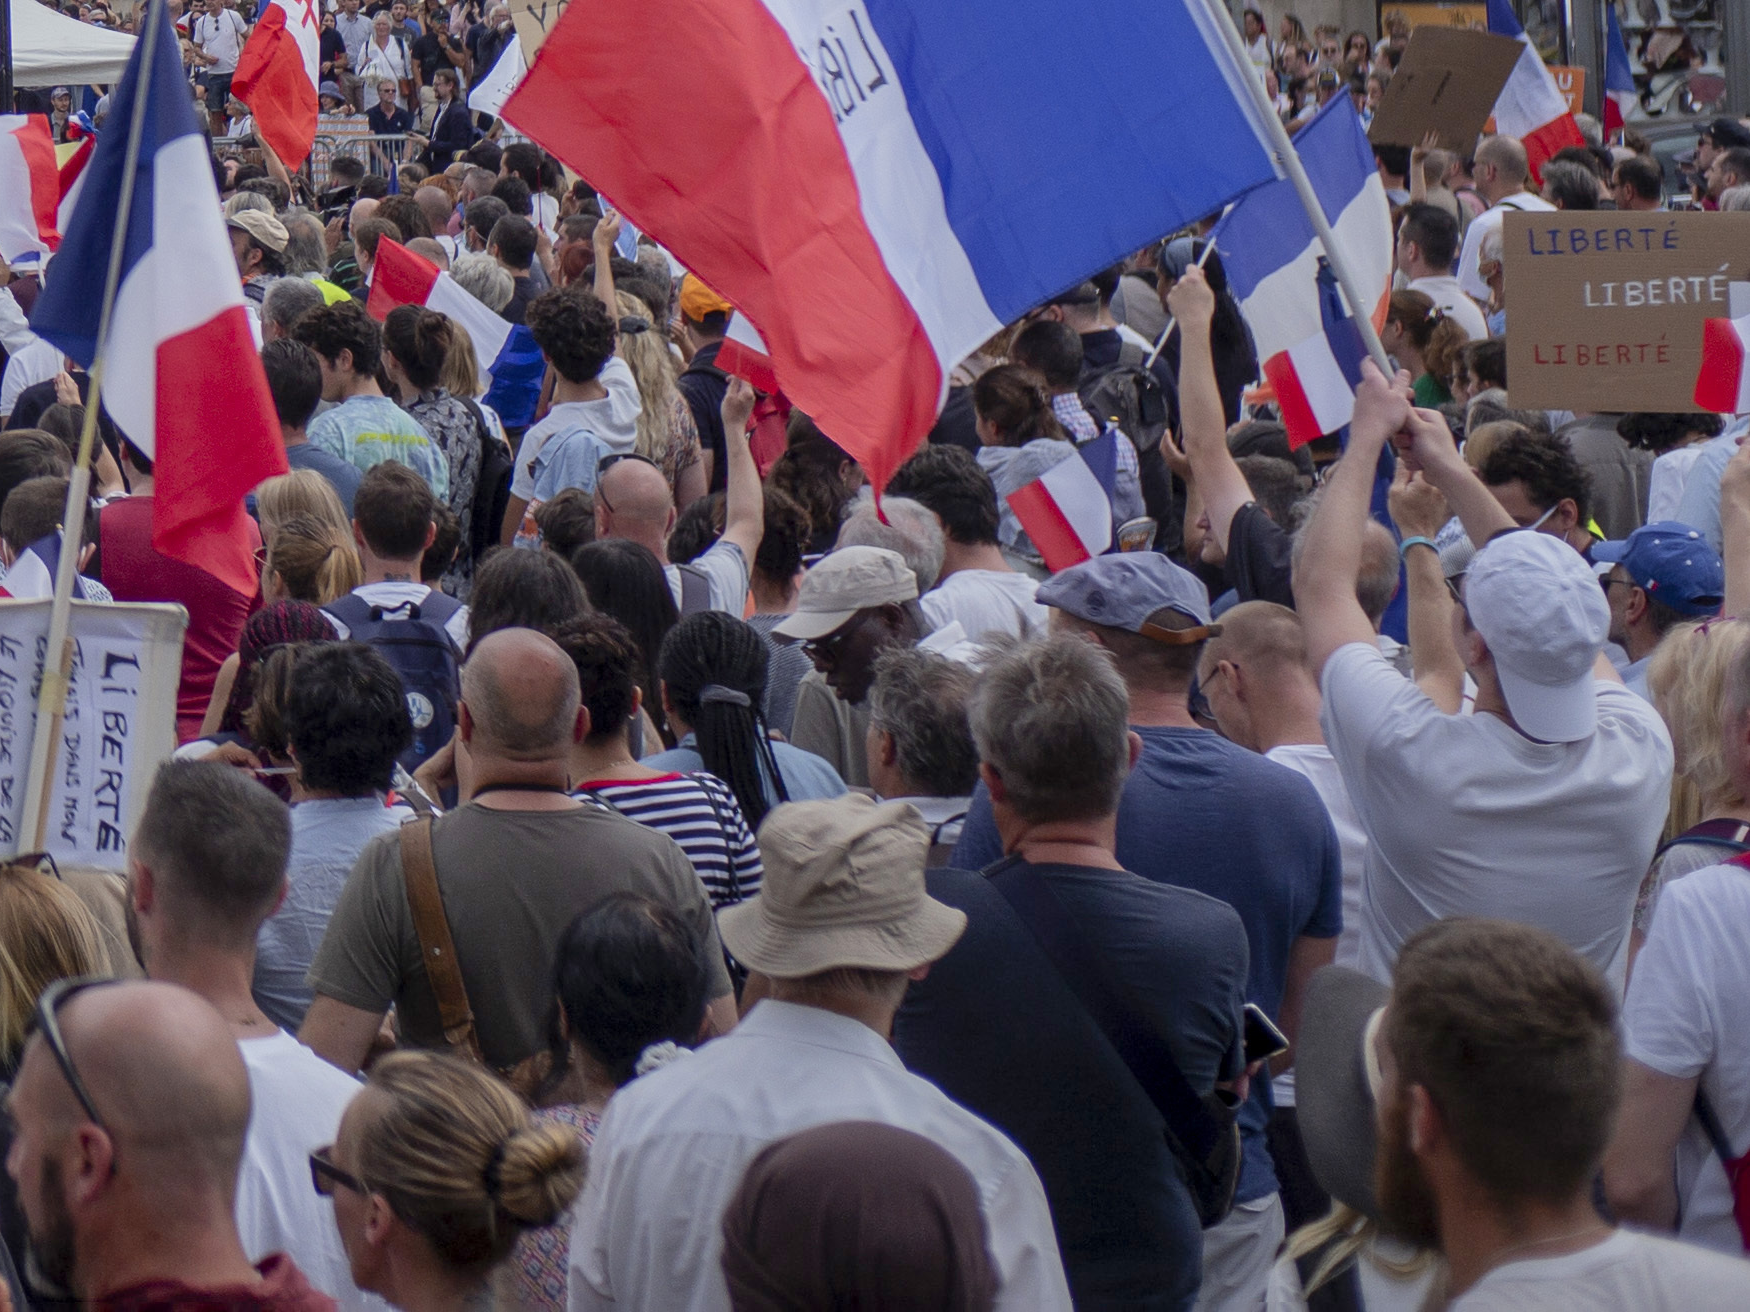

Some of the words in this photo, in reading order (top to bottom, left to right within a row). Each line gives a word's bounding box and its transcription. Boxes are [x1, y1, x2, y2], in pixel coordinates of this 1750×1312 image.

[1528, 220, 1680, 256] LIBERTÉ
[1584, 263, 1730, 307] LIBERTÉ
[1533, 333, 1670, 367] LIBERTÉ
[0, 633, 24, 662] LE
[63, 732, 82, 789] DANS
[0, 776, 15, 810] DE
